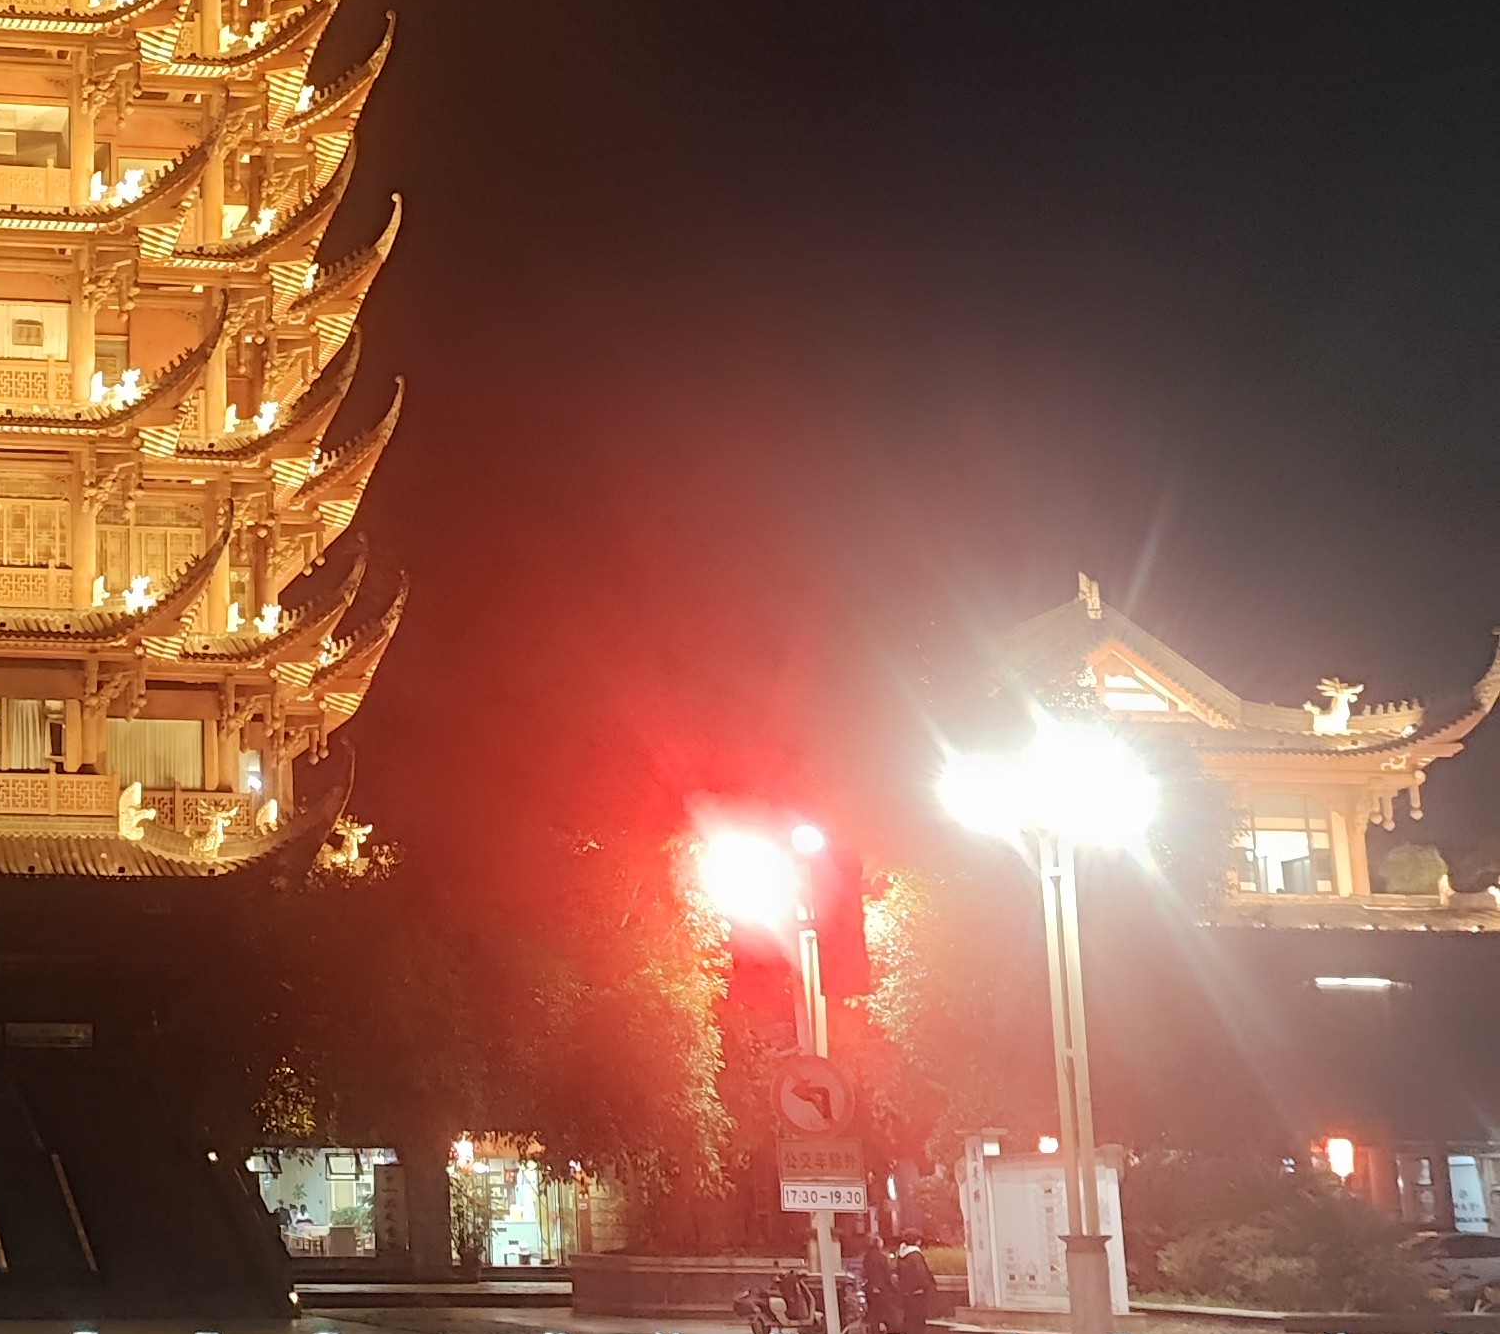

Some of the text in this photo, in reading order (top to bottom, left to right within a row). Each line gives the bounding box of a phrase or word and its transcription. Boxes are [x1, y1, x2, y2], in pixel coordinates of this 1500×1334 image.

[784, 1151, 858, 1170] 公交车除外
[785, 1190, 862, 1205] 17:30-19:30
